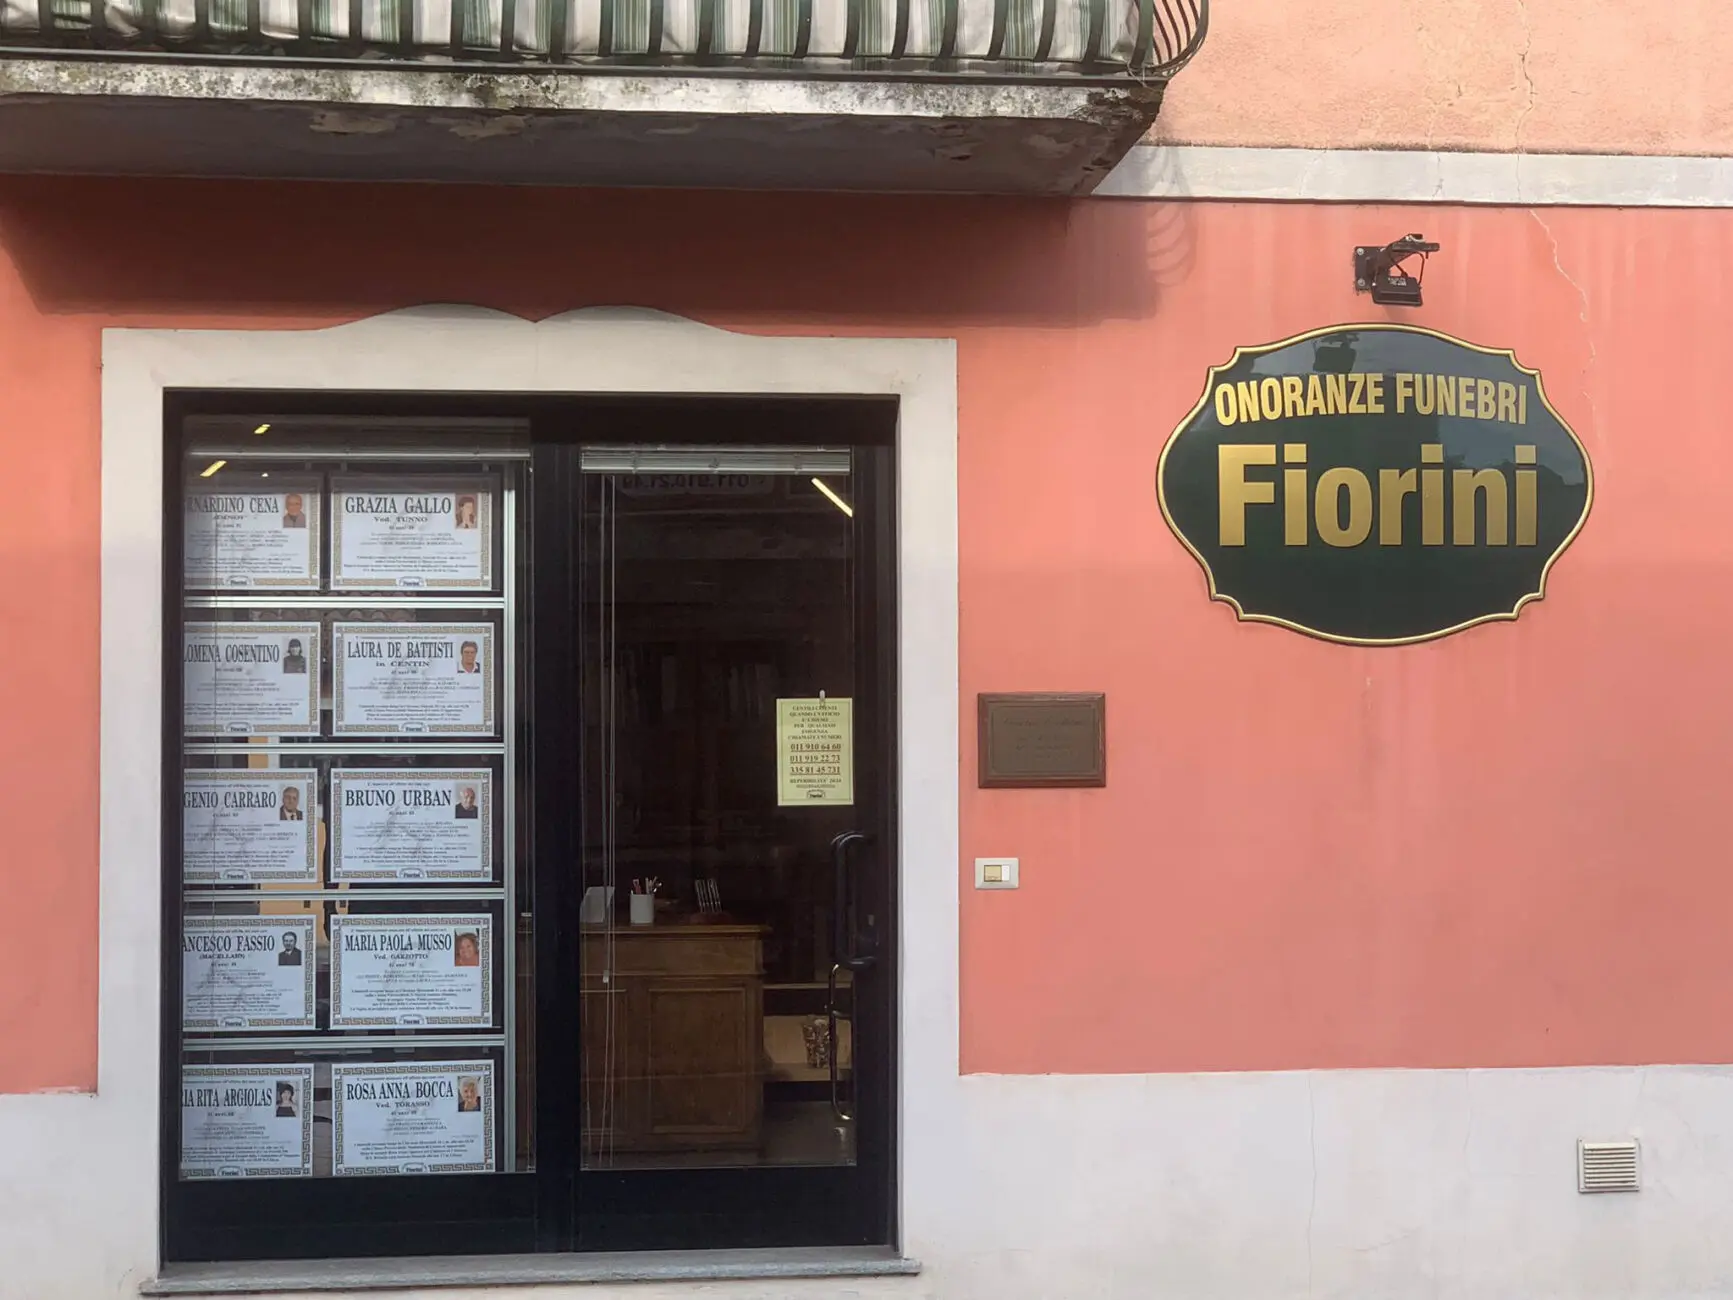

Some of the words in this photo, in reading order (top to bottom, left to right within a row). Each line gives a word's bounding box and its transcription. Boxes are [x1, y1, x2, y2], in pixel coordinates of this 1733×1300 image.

[1214, 372, 1385, 426] ONORANZE
[1396, 372, 1527, 425] FUNEBRI
[1218, 443, 1537, 547] Fiorini
[188, 497, 244, 514] NARDINO
[250, 497, 279, 513] CENA
[345, 497, 398, 514] GRAZIA
[405, 497, 451, 514] GALLO
[225, 644, 280, 663] COSENTINO
[348, 641, 382, 658] LAURA
[388, 641, 402, 658] DE
[408, 641, 453, 658] BATTISTI
[224, 791, 277, 808] CARRARO
[345, 789, 395, 807] BRUNO
[403, 789, 452, 806] URBAN
[237, 934, 275, 952] FASSIO
[345, 934, 378, 951] MARIA
[380, 934, 413, 951] PAOLA
[417, 934, 452, 951] MUSSO
[181, 1088, 194, 1107] IA
[197, 1088, 220, 1106] RITA
[223, 1087, 273, 1106] ARGIOLAS
[347, 1083, 377, 1101] ROSA
[378, 1082, 410, 1099] ANNA
[416, 1080, 454, 1098] BOCCA
